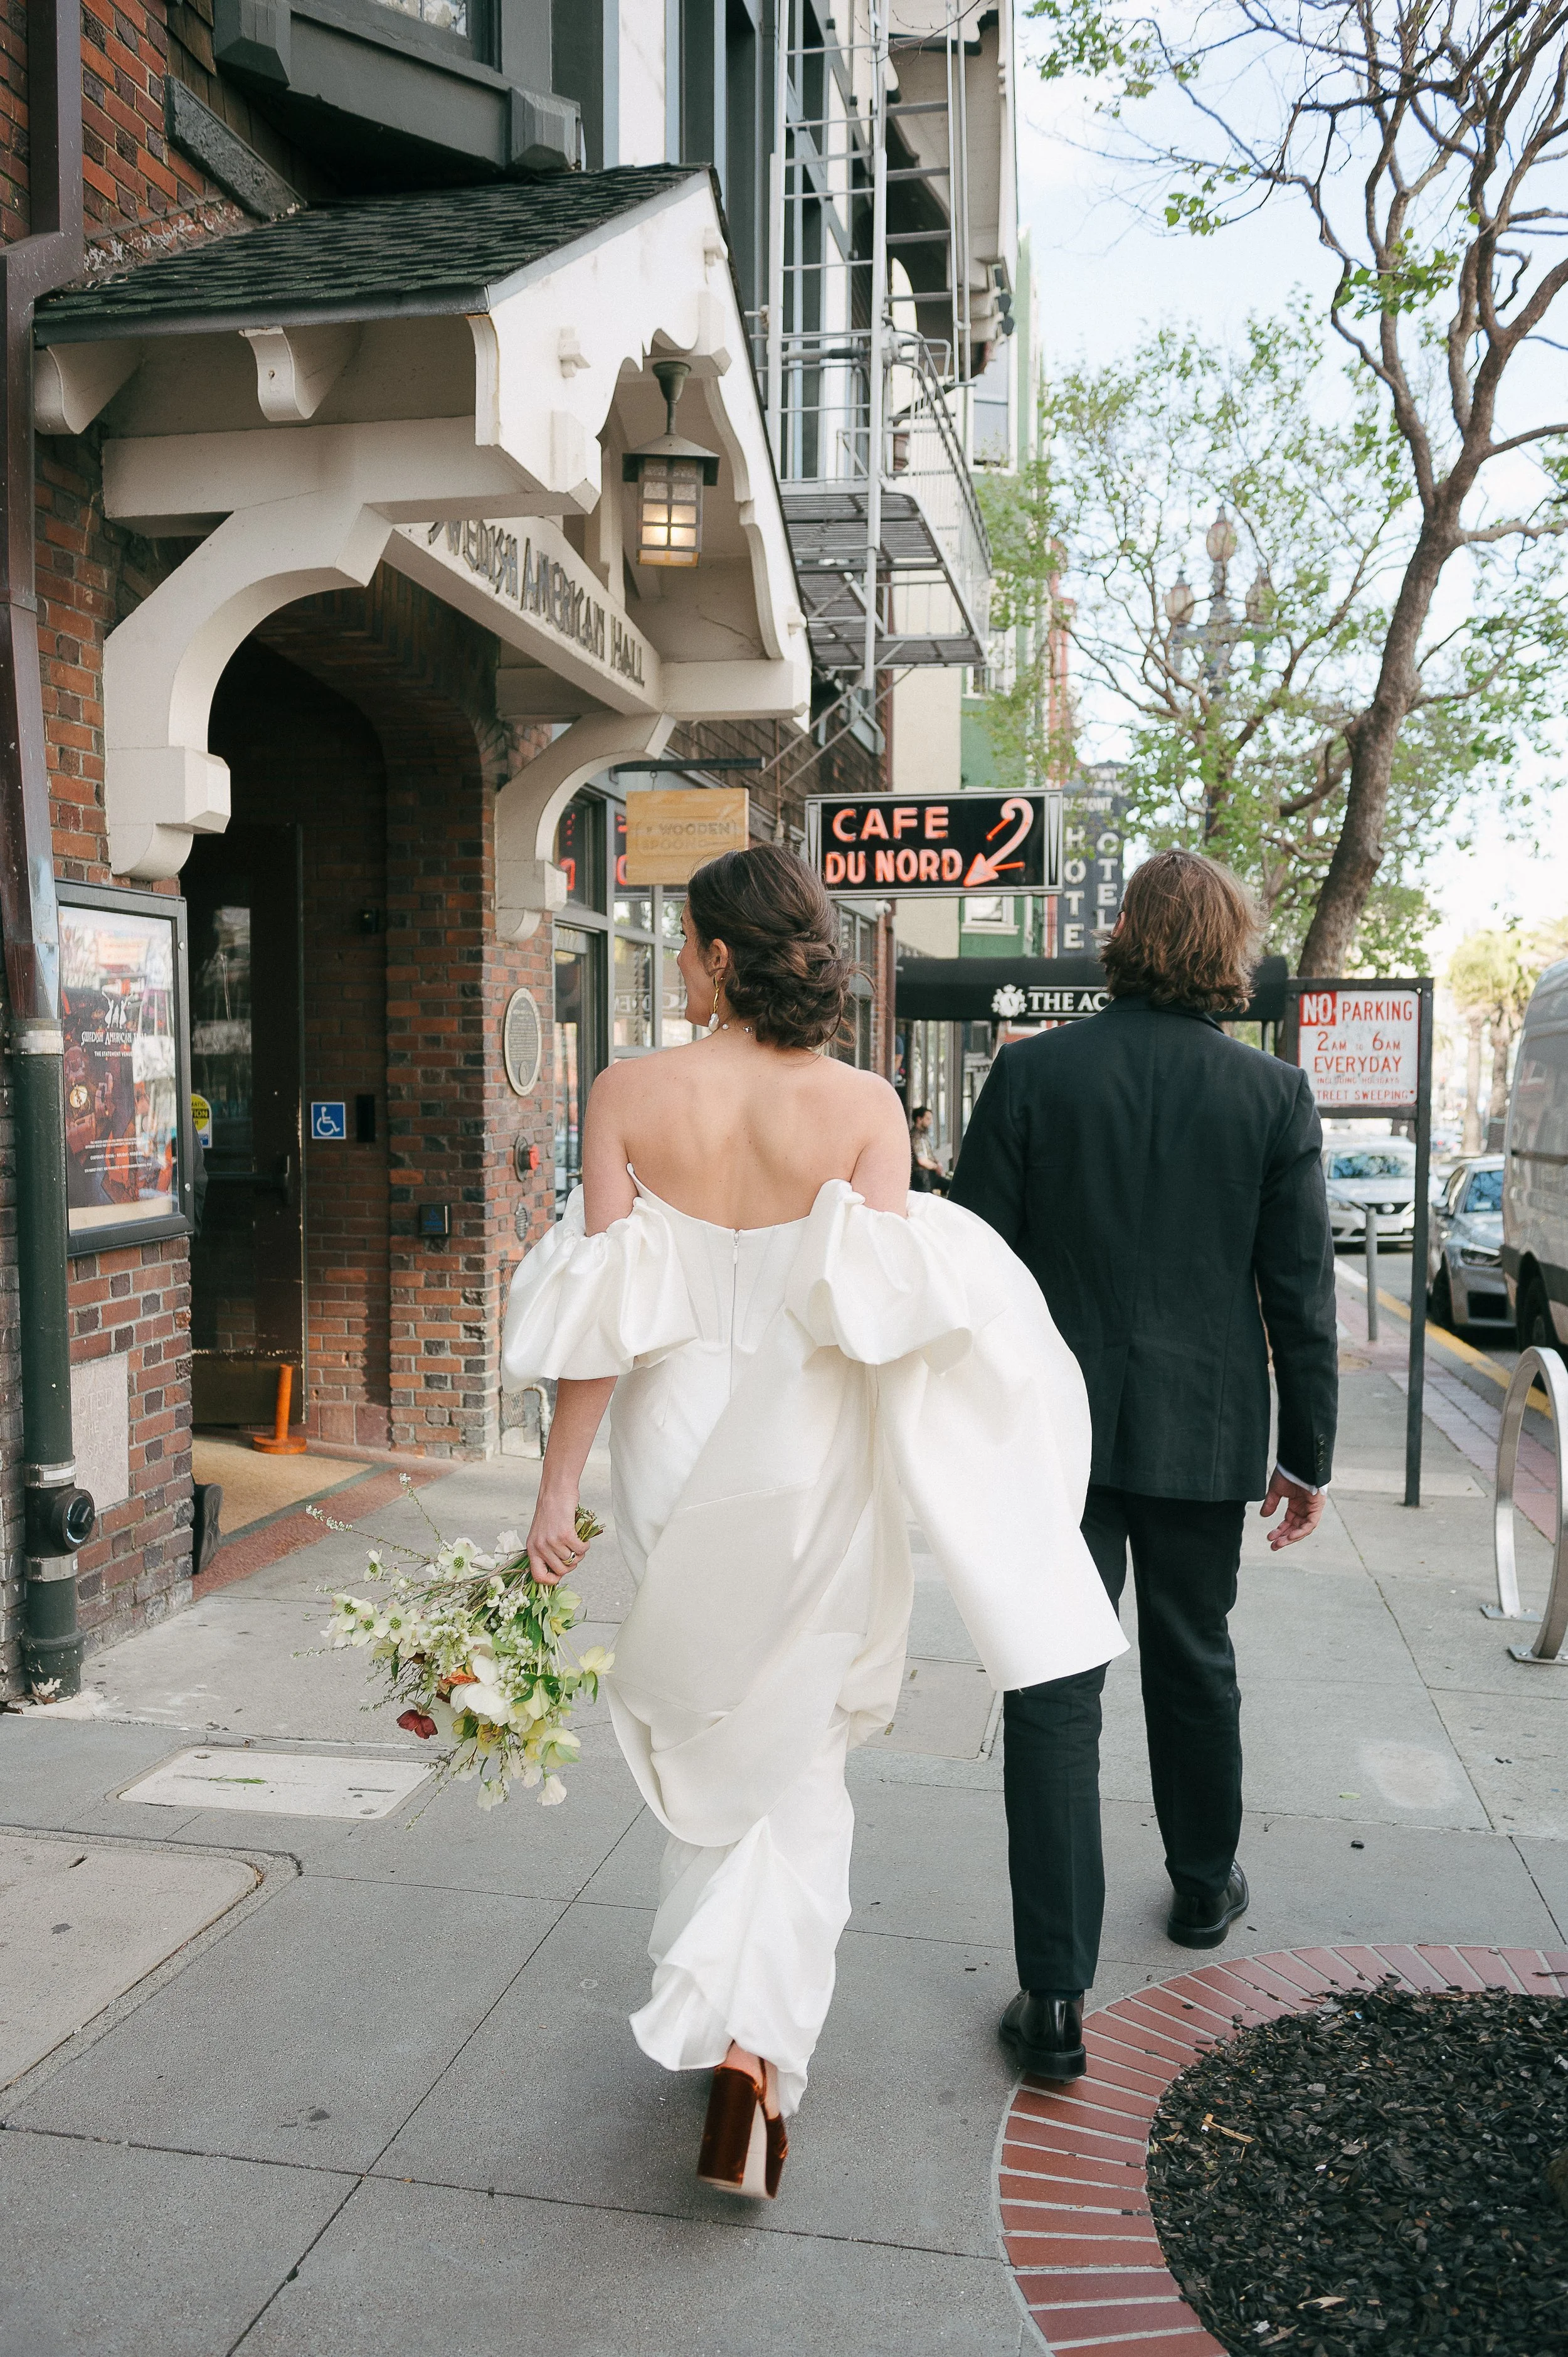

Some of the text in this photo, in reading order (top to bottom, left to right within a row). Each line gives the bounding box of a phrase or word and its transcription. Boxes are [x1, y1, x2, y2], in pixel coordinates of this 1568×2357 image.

[428, 520, 645, 689] WEDISH AMERICAN HALL
[659, 822, 730, 836] WOODEN
[832, 806, 948, 842] CAFE
[825, 848, 963, 884] DU NORD
[1027, 992, 1074, 1011] THE
[1303, 993, 1413, 1024] NO PARKING
[1315, 1056, 1402, 1073] EVERYDAY
[1316, 1090, 1408, 1101] TREET SWEEPING
